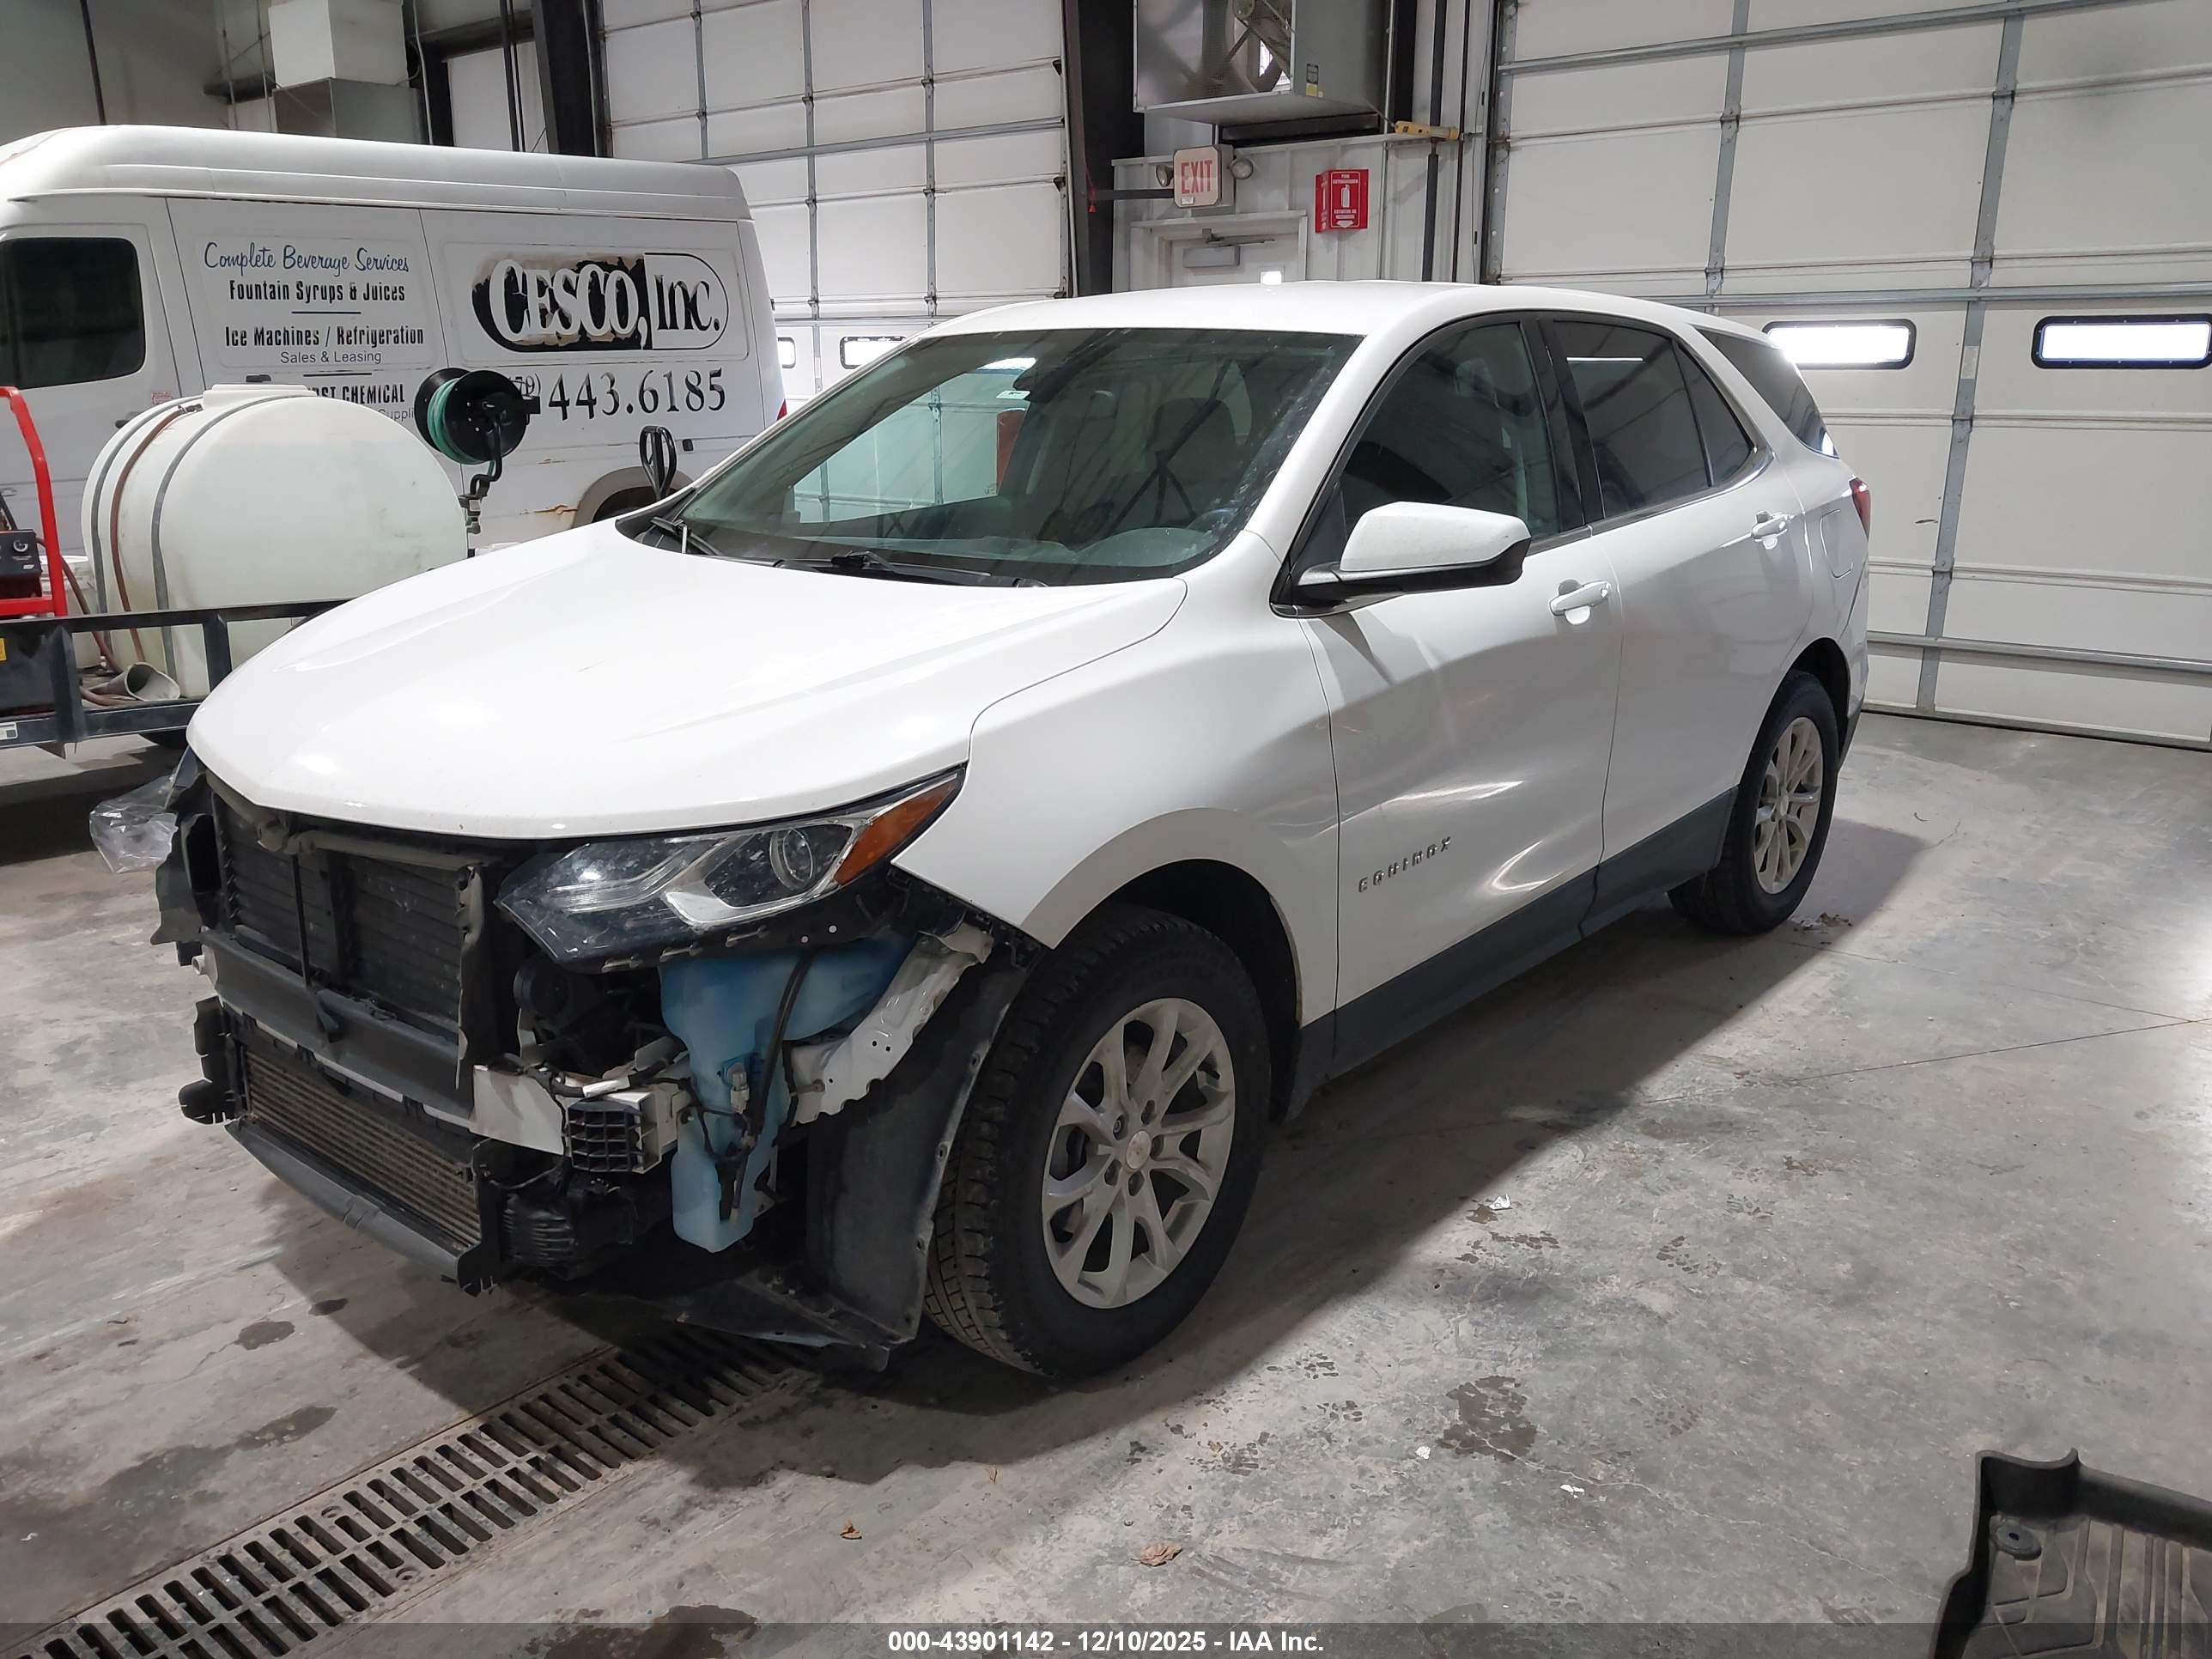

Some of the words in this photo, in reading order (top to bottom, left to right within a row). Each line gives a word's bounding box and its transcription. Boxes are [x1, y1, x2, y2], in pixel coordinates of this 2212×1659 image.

[1181, 160, 1212, 194] EXIT
[204, 242, 276, 276] Complete
[283, 245, 349, 276] Beverage
[355, 247, 409, 272] Services
[229, 280, 289, 301] Fountain
[296, 280, 343, 303] Syrups
[349, 282, 357, 301] &
[363, 282, 405, 301] Juices
[654, 274, 720, 331] Inc.
[225, 326, 247, 346] Ice
[254, 325, 319, 346] Machines
[325, 326, 331, 347] /
[337, 325, 424, 348] Refrigeration
[280, 351, 315, 363] Sales
[320, 351, 330, 363] &
[334, 350, 381, 364] Leasing
[342, 384, 404, 404] CHEMICAL
[548, 367, 726, 421] 443.6185
[1358, 836, 1451, 893] EQUINOX
